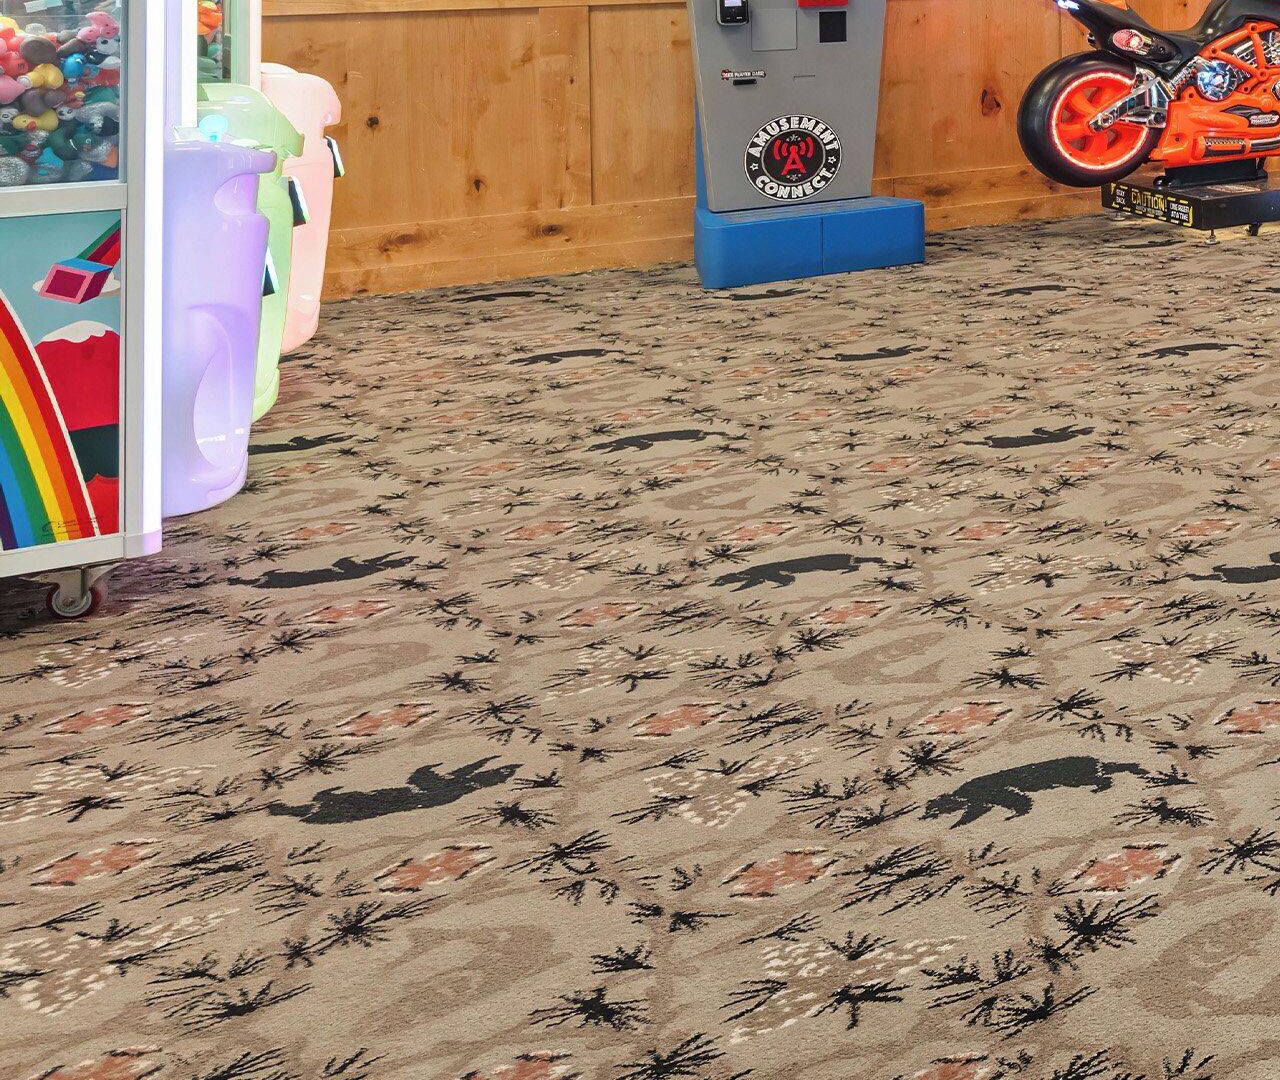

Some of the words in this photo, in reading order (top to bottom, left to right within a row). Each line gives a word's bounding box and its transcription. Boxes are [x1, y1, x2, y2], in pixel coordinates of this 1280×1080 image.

[747, 116, 839, 158] AMUSEMENT
[755, 167, 834, 199] CONNECT
[1131, 191, 1168, 212] CAUTION!
